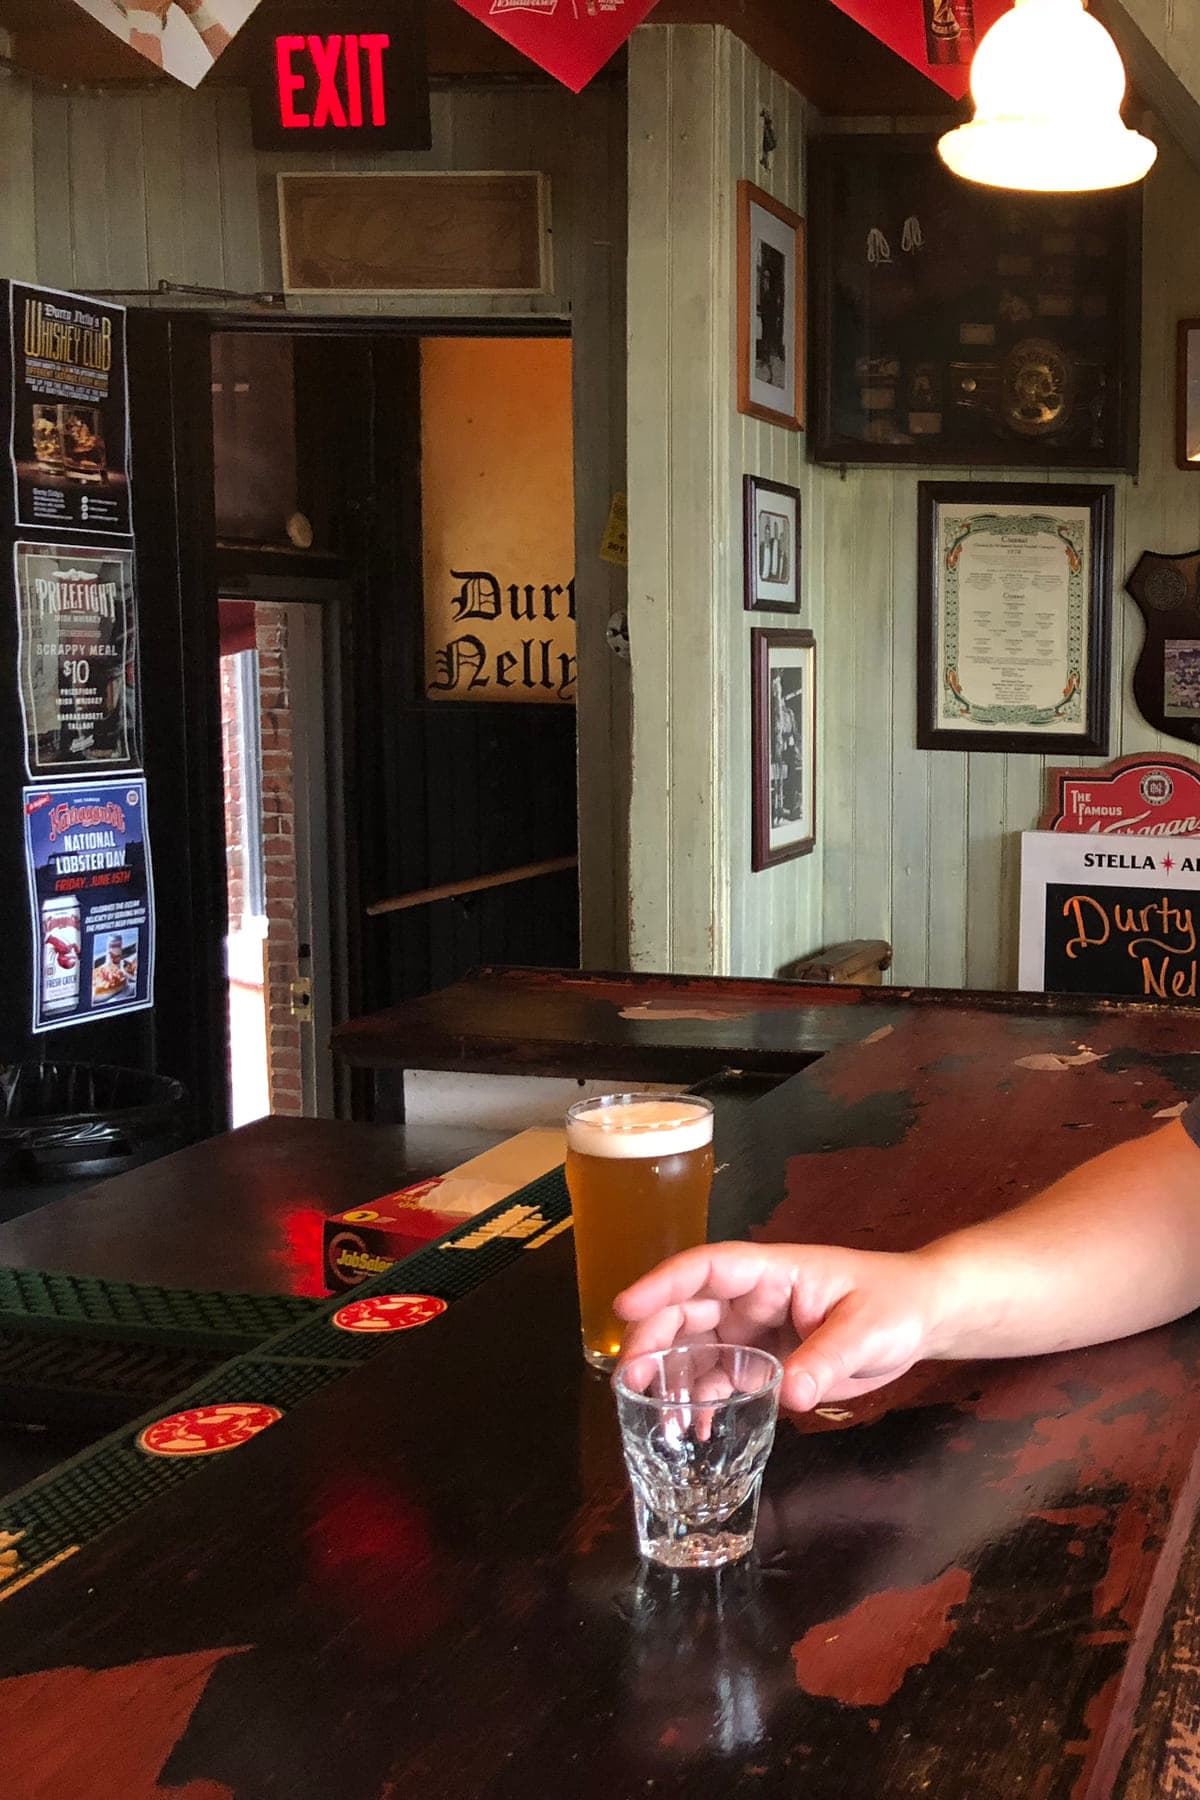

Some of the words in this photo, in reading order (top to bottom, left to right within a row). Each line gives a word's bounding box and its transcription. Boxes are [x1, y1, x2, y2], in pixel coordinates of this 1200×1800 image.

[275, 33, 390, 128] EXIT
[43, 303, 72, 321] Durty
[24, 298, 82, 364] WHISKEY
[83, 316, 112, 372] CLUB
[35, 578, 117, 623] PRIZEFIGHT
[36, 644, 86, 656] SCRAPPY
[89, 644, 118, 656] MEAL
[63, 660, 90, 684] $10
[1071, 790, 1092, 814] THE
[1079, 803, 1123, 825] FAMOUS
[64, 831, 116, 852] NATIONAL
[56, 852, 104, 875] LOBSTER
[106, 850, 126, 868] DAY
[1084, 853, 1156, 870] STELLA
[90, 874, 111, 887] JUNE
[111, 870, 132, 884] 15TH
[1063, 895, 1196, 959] Durty
